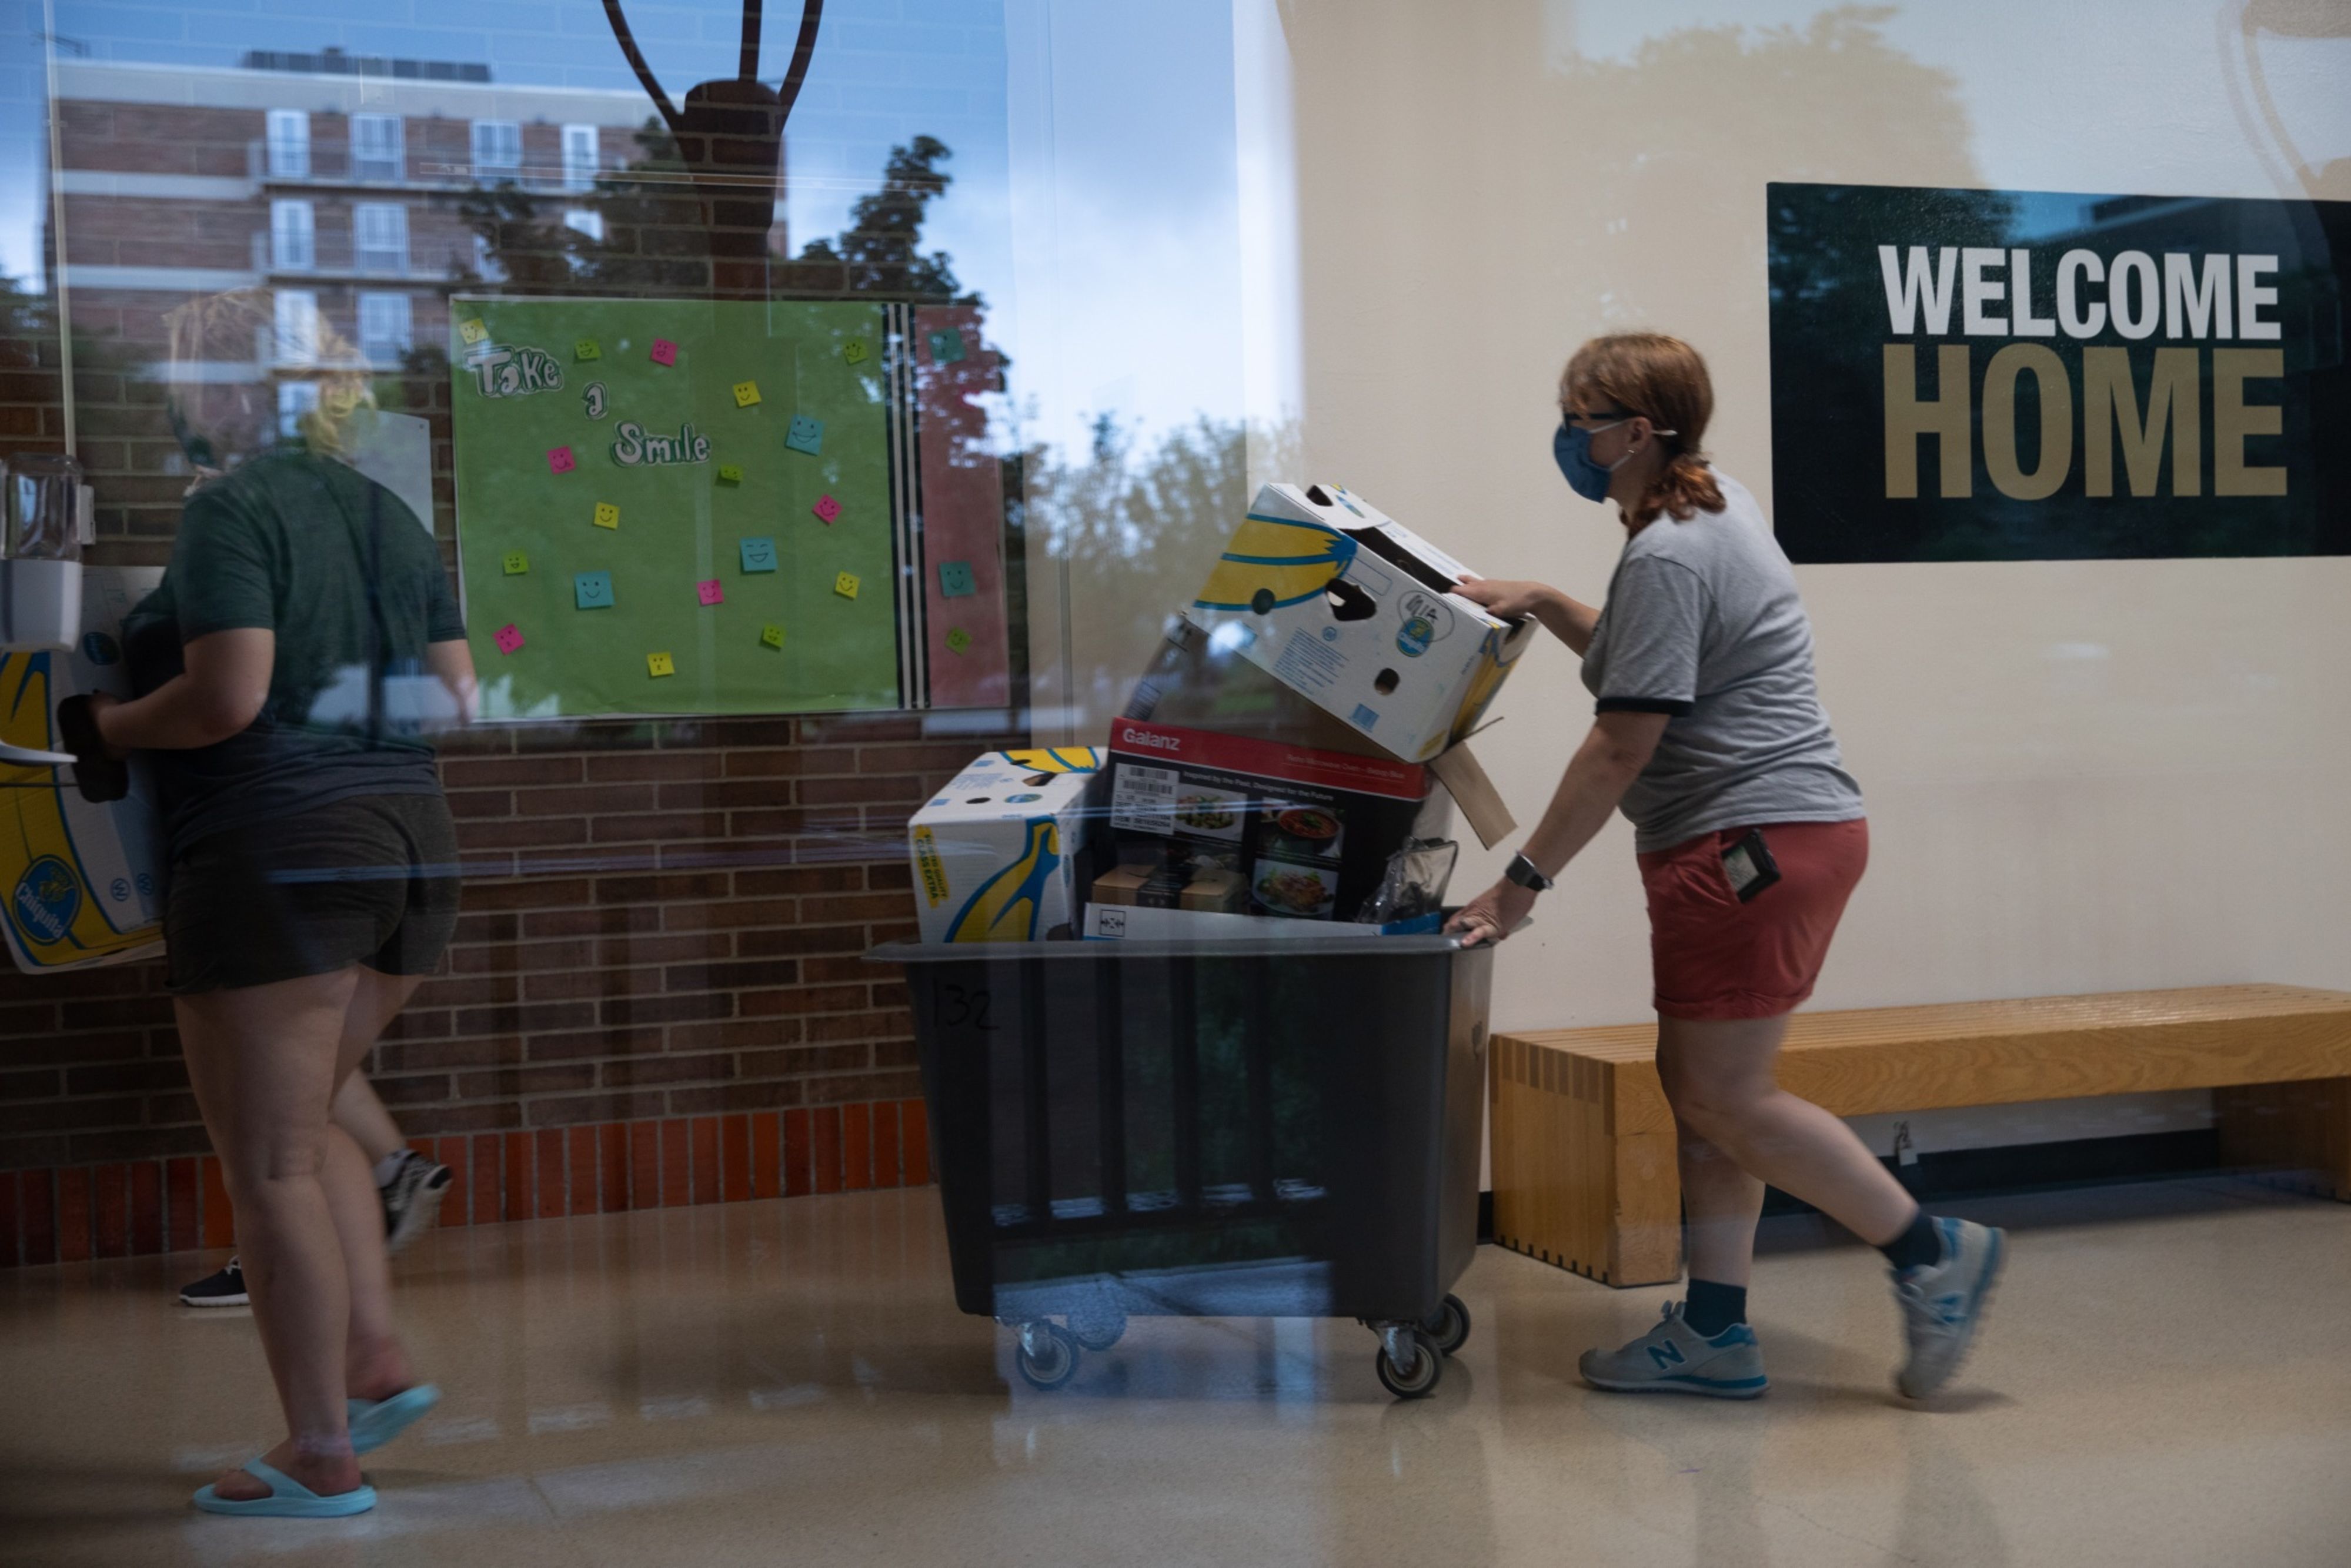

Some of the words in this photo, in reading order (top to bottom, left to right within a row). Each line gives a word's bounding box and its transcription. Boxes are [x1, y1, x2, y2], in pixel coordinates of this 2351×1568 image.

[1879, 245, 2282, 340] WELCOME
[467, 346, 561, 395] Take
[583, 382, 606, 417] a
[1883, 342, 2287, 501] HOME
[612, 422, 709, 466] Smile
[1123, 728, 1181, 751] Galanz
[916, 838, 930, 868] CLASS
[924, 868, 940, 900] EXTRA
[15, 882, 65, 939] Chiquita
[933, 975, 1000, 1031] 132
[1647, 1339, 1686, 1370] N
